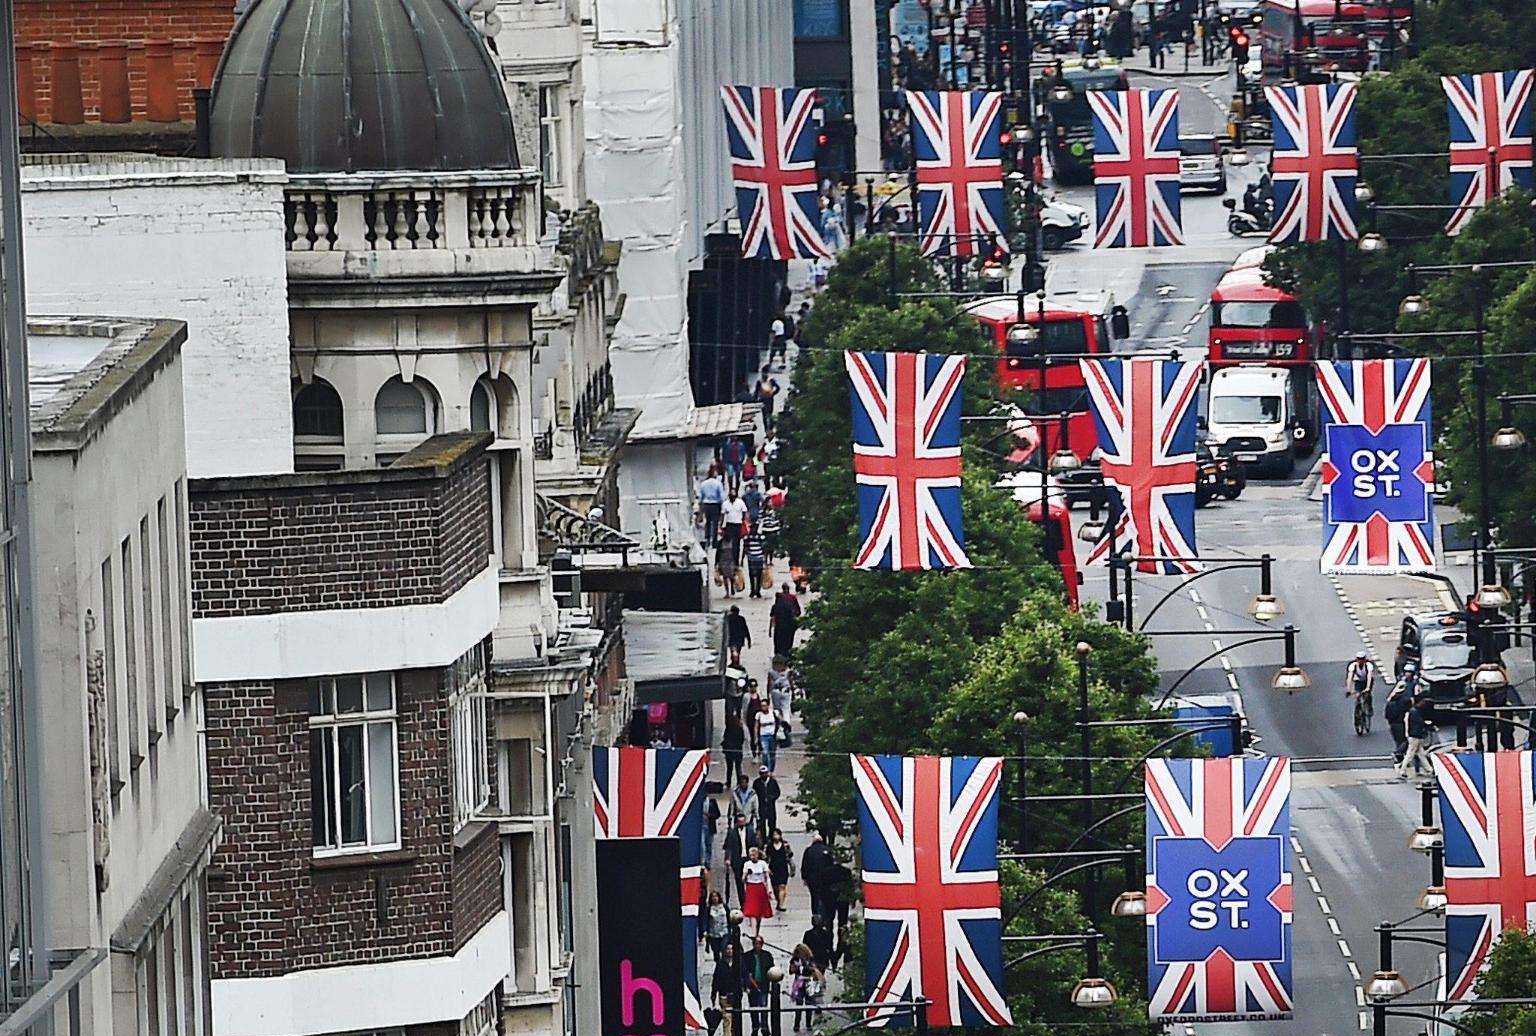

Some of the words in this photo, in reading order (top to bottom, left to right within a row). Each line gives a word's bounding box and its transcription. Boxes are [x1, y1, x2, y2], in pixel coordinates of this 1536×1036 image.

[1350, 449, 1400, 473] OX
[1352, 474, 1401, 498] ST.
[1187, 868, 1249, 899] OX
[1188, 900, 1249, 930] ST.
